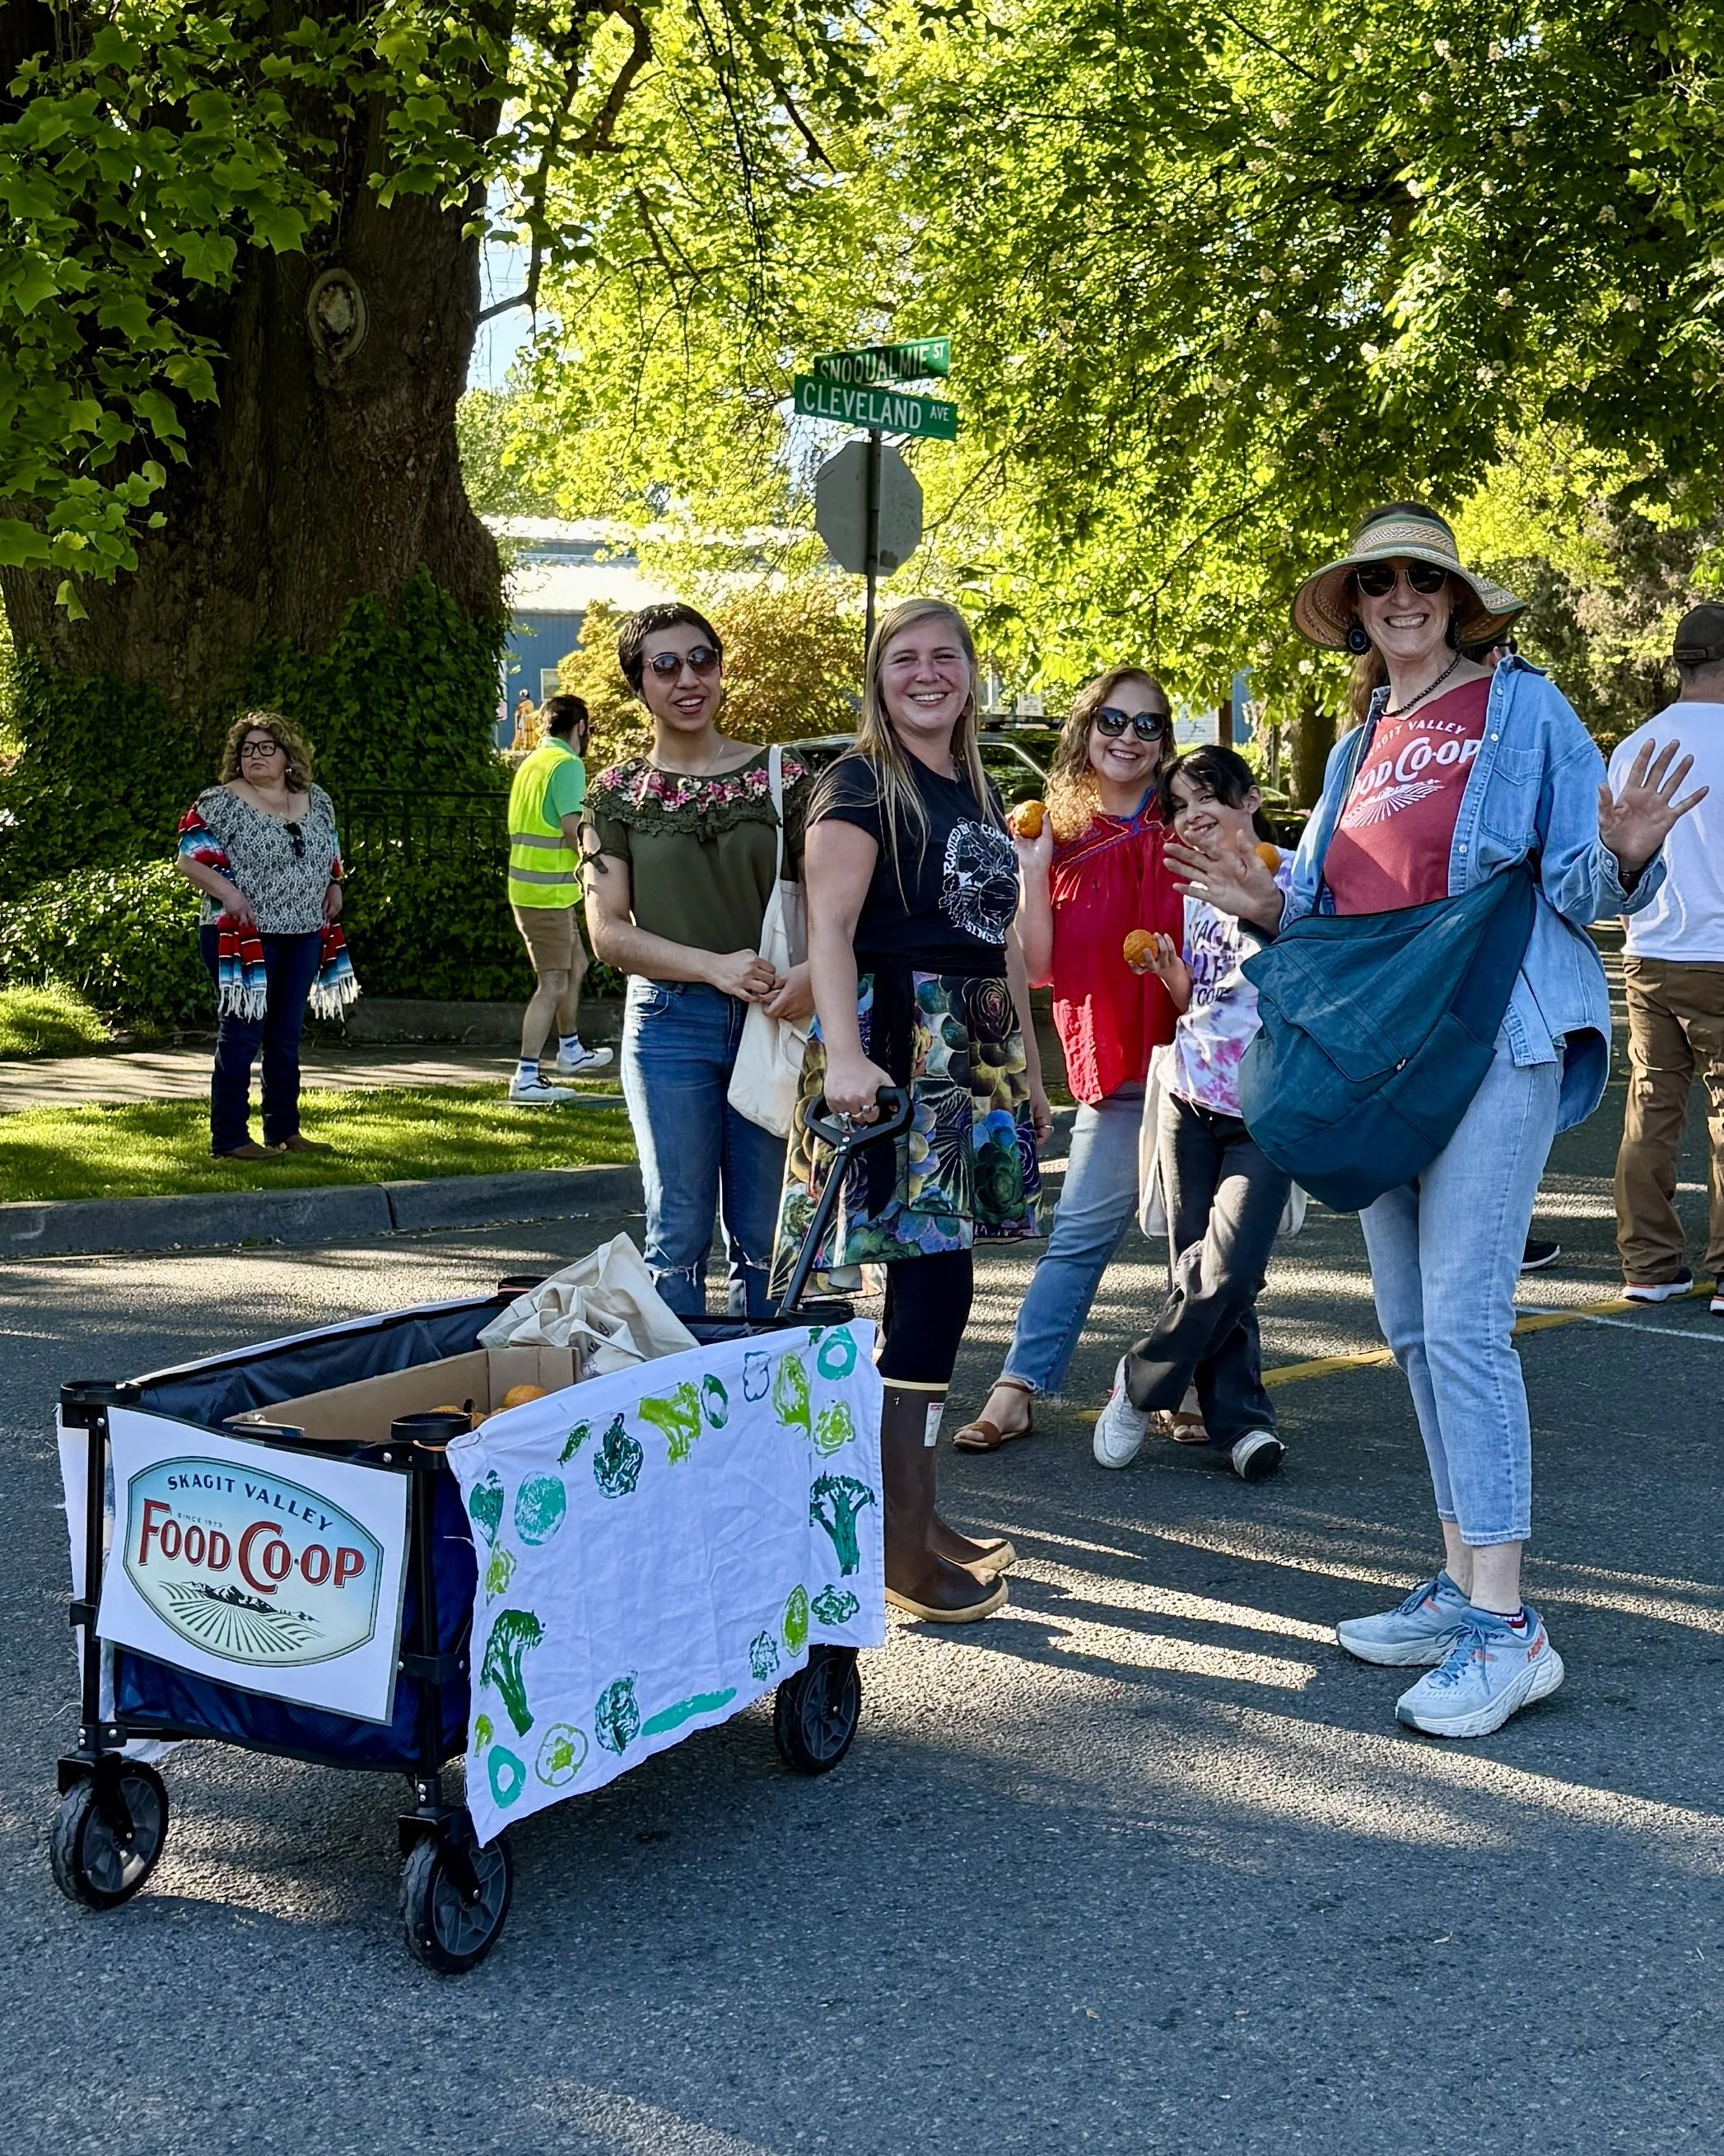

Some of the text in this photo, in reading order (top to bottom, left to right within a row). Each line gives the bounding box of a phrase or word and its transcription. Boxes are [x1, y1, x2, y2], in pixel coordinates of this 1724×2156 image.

[820, 343, 946, 385] SNOQUALMIE ST
[803, 381, 949, 430] CLEVELAND AVE
[1408, 719, 1466, 735] VALLEY
[943, 828, 962, 876] ROOTED
[167, 1473, 334, 1532] SKAGIT VALLEY
[177, 1512, 202, 1524] SINCE
[137, 1498, 232, 1571] FOOD
